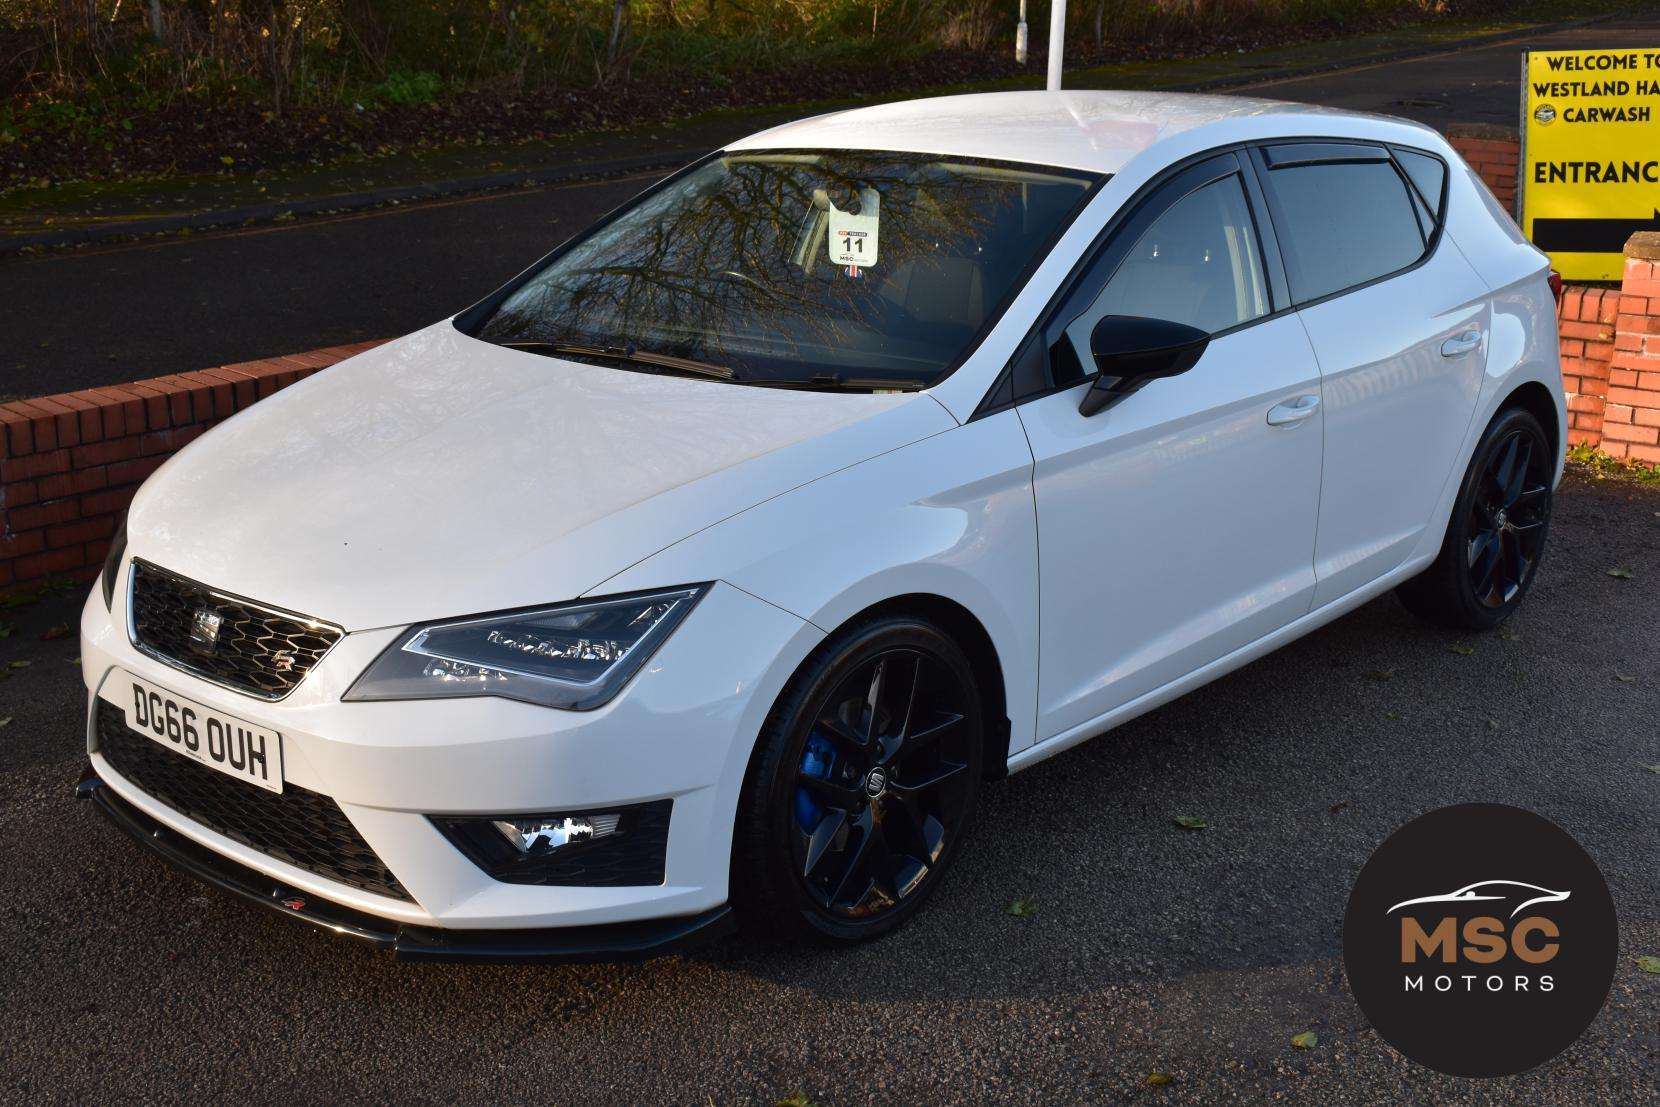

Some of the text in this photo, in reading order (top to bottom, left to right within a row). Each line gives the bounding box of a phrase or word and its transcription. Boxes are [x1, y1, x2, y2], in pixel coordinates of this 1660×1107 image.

[1547, 54, 1637, 71] WELCOME
[1533, 80, 1660, 97] WESTLAND HA
[1563, 107, 1650, 122] CARWASH
[1535, 161, 1658, 183] ENTRANC
[843, 237, 862, 252] 11
[132, 682, 268, 781] DG66 OUH
